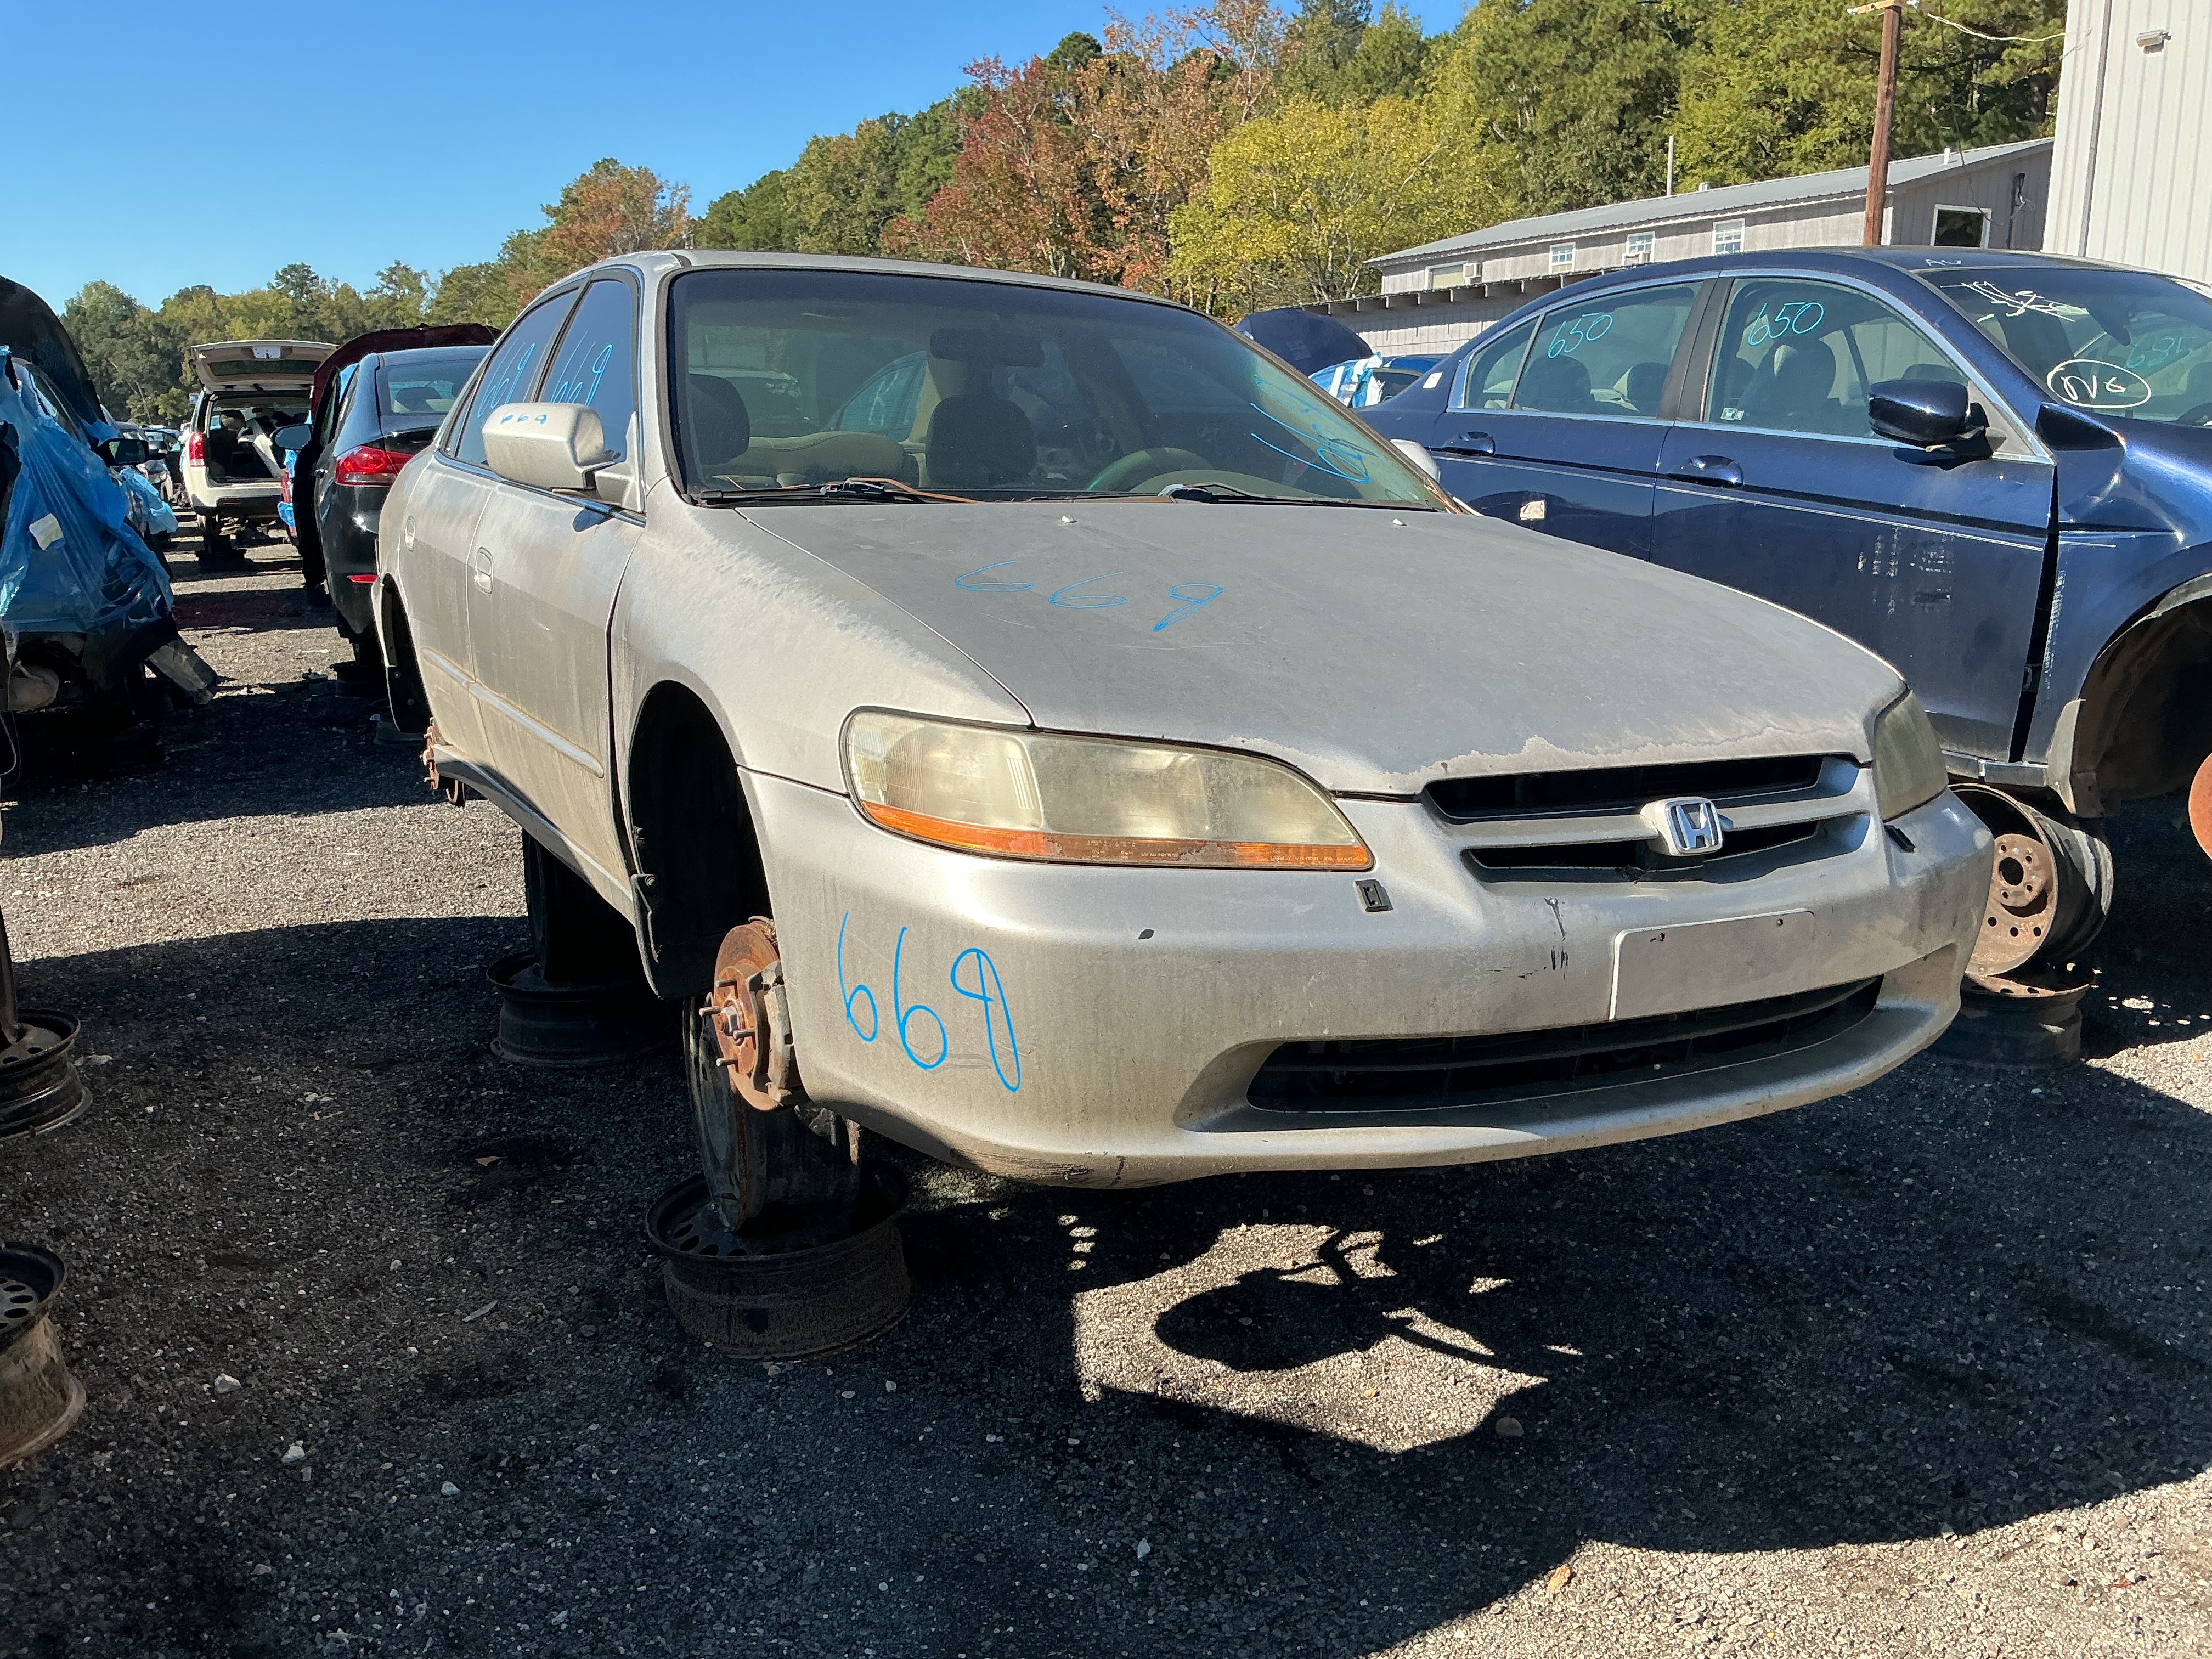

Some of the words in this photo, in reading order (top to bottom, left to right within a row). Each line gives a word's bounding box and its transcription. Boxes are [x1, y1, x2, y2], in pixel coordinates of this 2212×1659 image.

[1547, 312, 1613, 359] 650
[1747, 302, 1825, 346] 650
[550, 330, 613, 408] 669
[954, 559, 1228, 632] 669
[837, 910, 1022, 1093] 669
